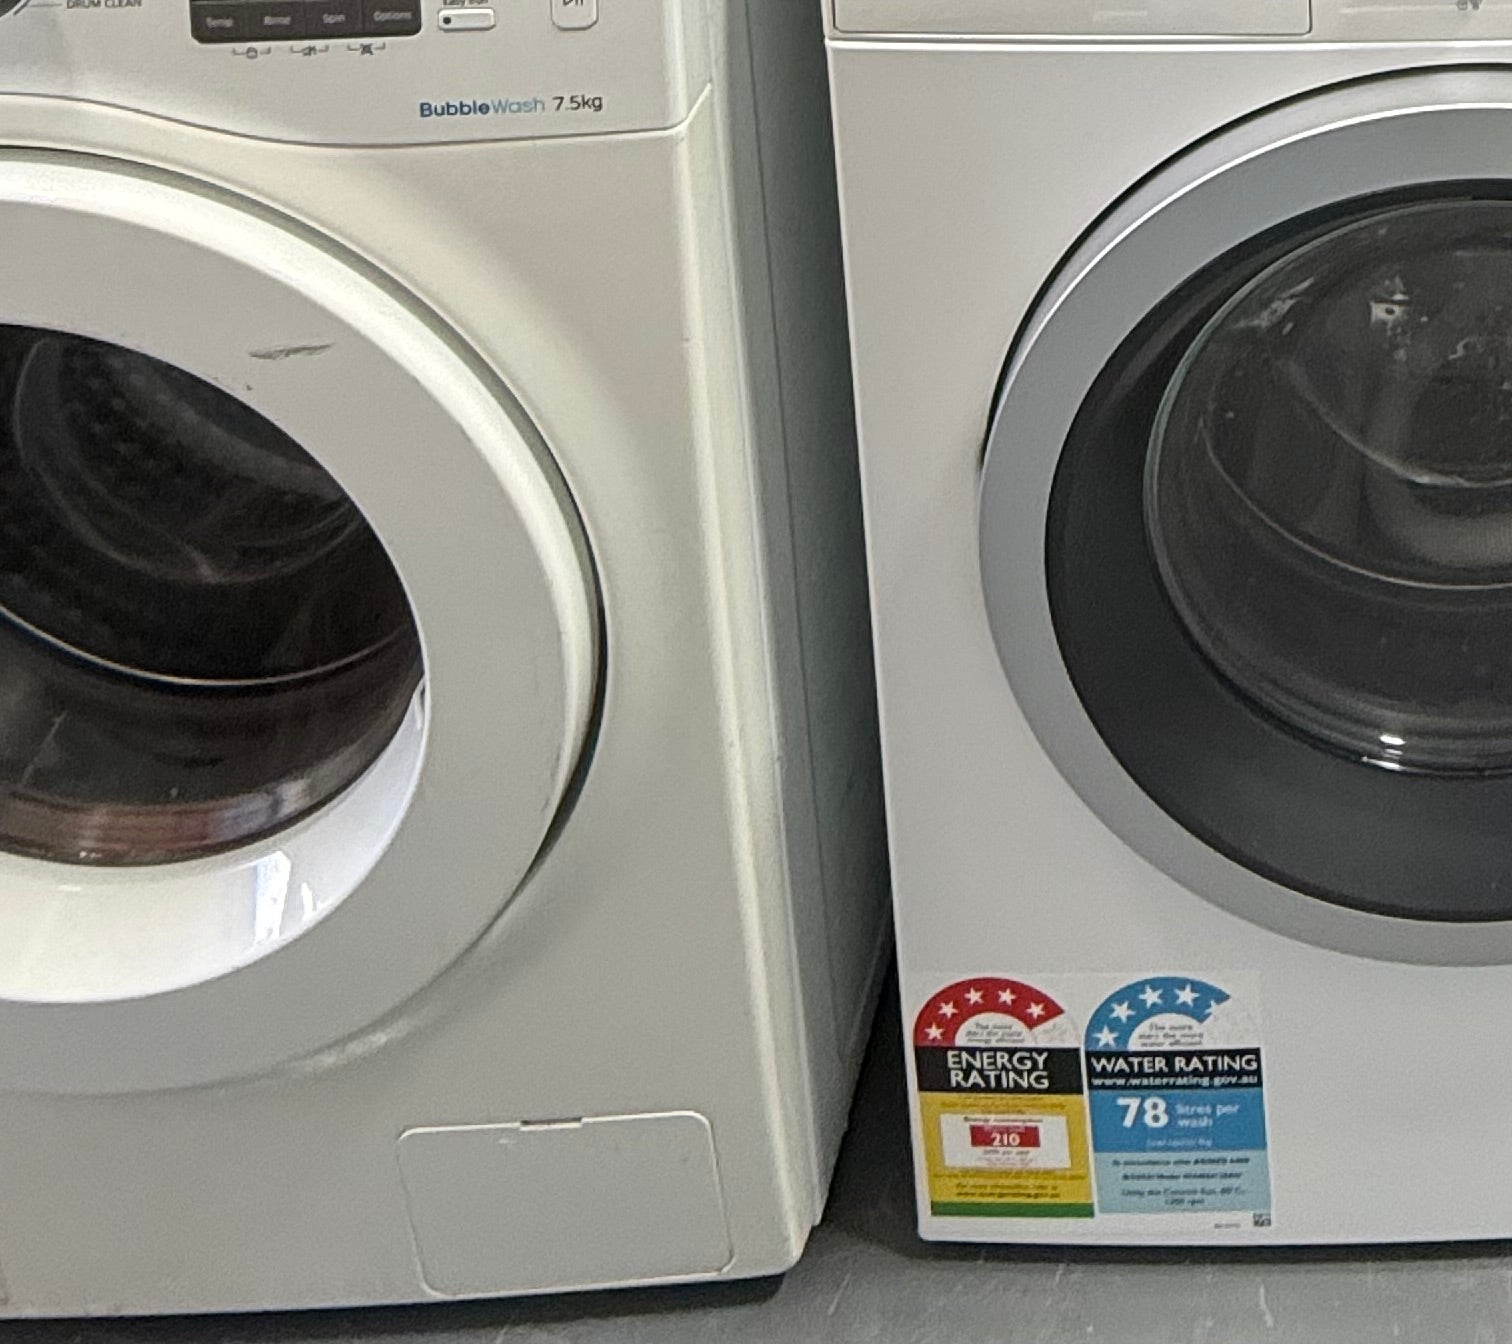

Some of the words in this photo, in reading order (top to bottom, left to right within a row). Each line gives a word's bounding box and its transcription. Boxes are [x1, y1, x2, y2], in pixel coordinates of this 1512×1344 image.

[419, 96, 545, 118] BubbleWash
[552, 94, 604, 113] 7.5kg
[947, 1050, 1049, 1070] ENERGY
[1090, 1056, 1169, 1074] WATER
[1174, 1054, 1259, 1073] RATING
[950, 1070, 1050, 1089] RATING
[1116, 1096, 1170, 1129] 78
[991, 1131, 1021, 1146] 210
